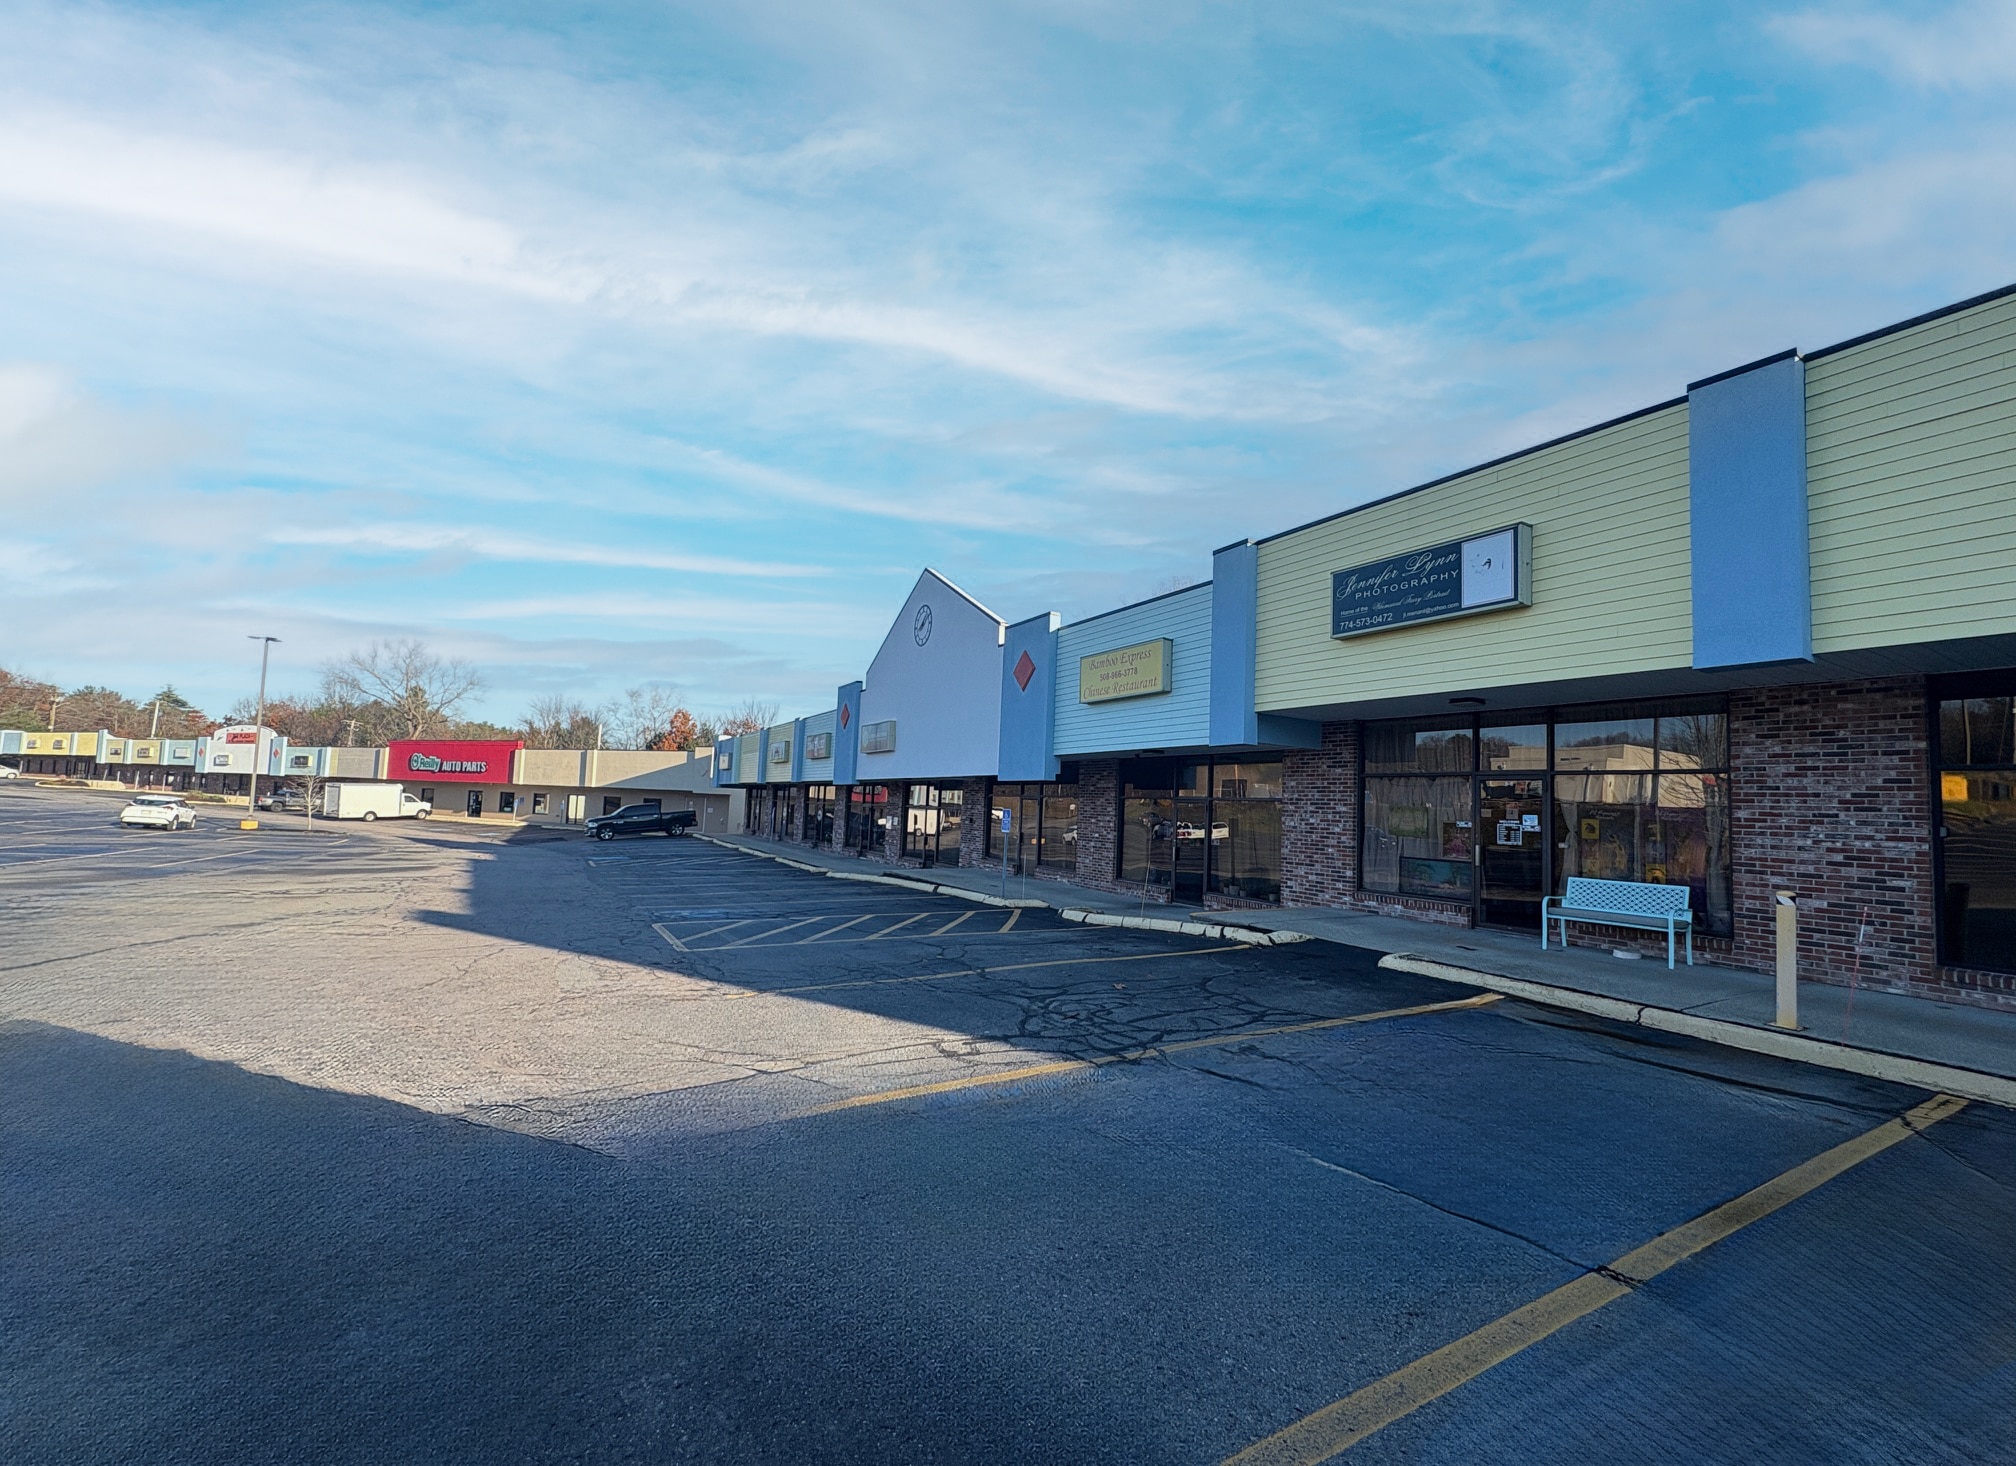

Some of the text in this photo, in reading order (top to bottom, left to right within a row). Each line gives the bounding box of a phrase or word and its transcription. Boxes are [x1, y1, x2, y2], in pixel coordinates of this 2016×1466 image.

[1336, 552, 1460, 601] Jennifer Lynn
[1355, 569, 1459, 600] PHOTOGRAPHY
[1339, 613, 1393, 631] 774-573-0472
[1088, 650, 1152, 670] Bamboo Express
[1083, 677, 1158, 699] Chinese Restaurant
[441, 761, 461, 771] AUTO
[462, 761, 487, 772] PARTS
